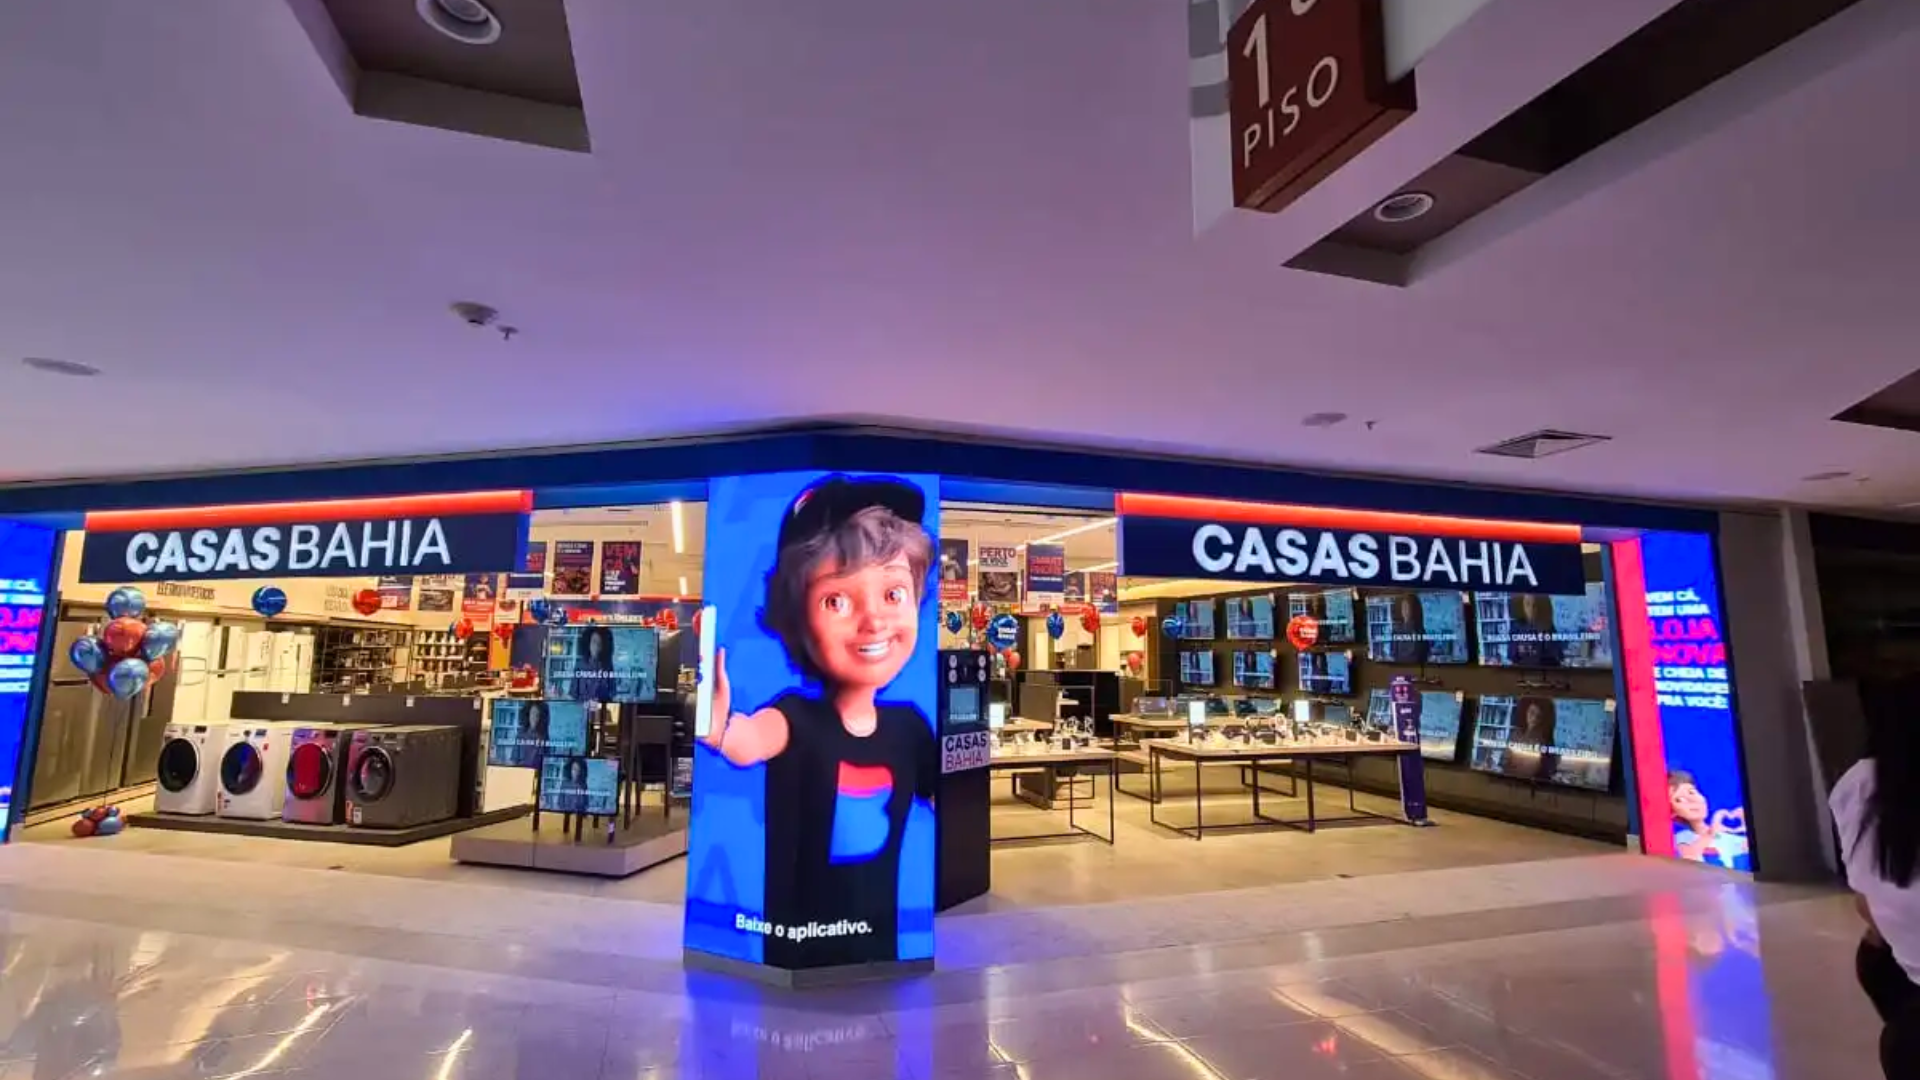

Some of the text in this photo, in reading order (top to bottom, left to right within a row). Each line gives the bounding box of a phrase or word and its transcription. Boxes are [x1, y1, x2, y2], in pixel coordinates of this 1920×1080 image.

[1243, 56, 1338, 168] PISO
[126, 518, 451, 574] CASAS BAHIA
[979, 547, 1016, 559] PERTO
[1192, 524, 1538, 587] CASAS BAHIA
[945, 732, 987, 752] CASAS
[946, 751, 983, 771] BAHIA
[736, 913, 872, 943] Baixe o aplicativo.
